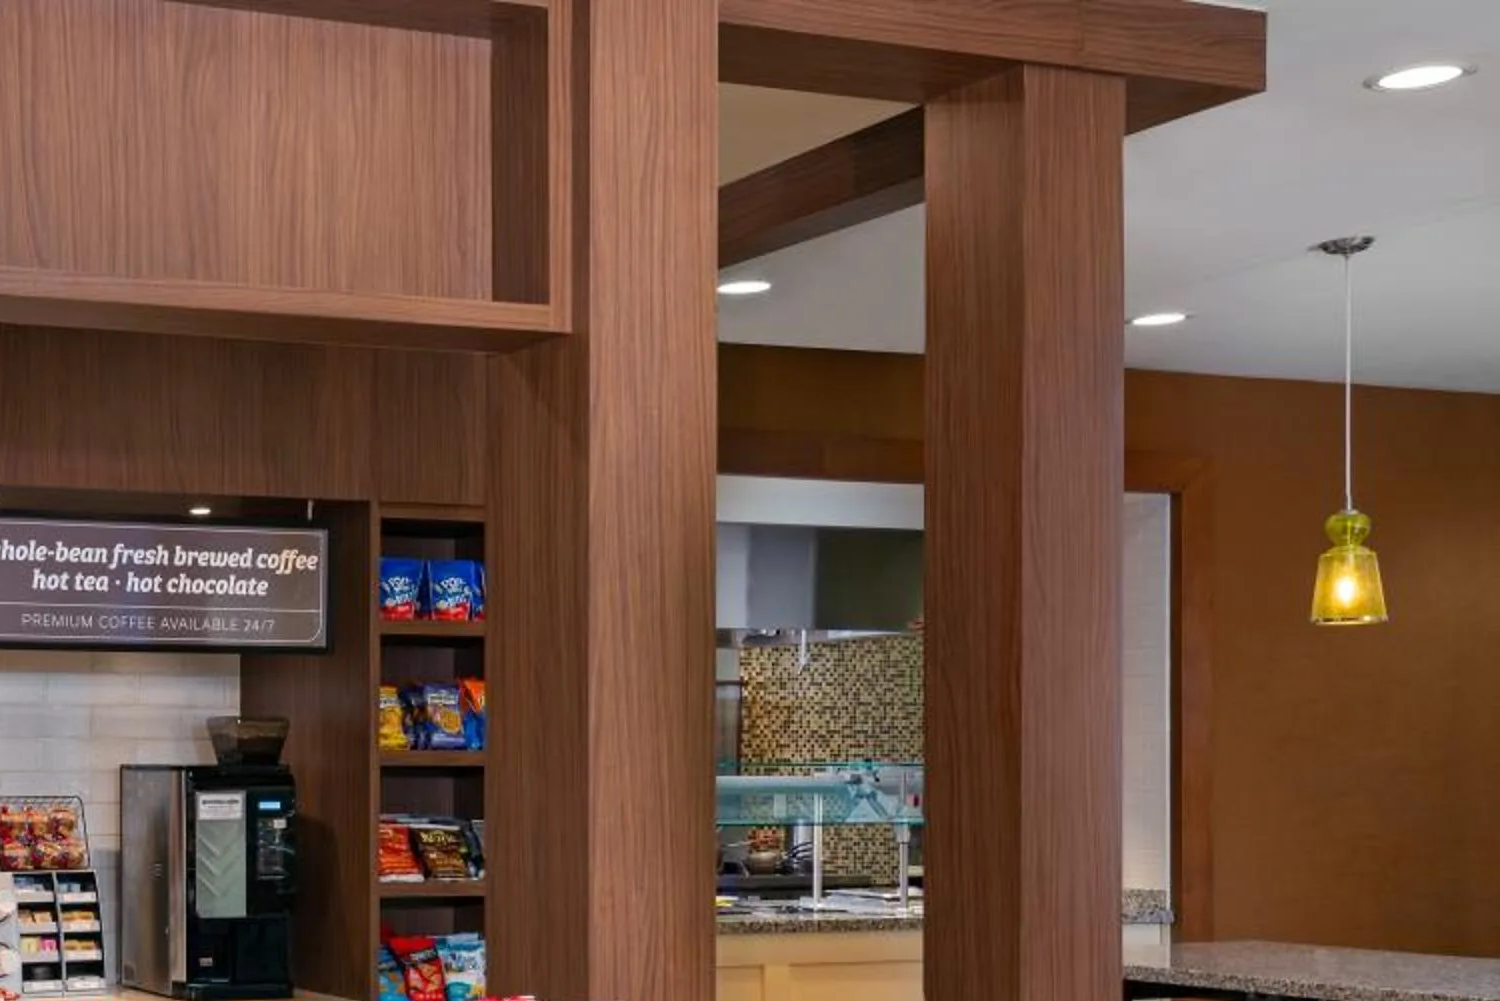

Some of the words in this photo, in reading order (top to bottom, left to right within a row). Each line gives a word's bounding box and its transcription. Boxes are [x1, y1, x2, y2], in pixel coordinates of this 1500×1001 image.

[109, 543, 173, 570] fresh
[174, 545, 252, 570] brewed
[248, 549, 319, 575] coffee
[32, 569, 70, 591] hot
[75, 573, 109, 592] tea
[126, 572, 162, 594] hot
[166, 573, 269, 597] chocolate
[20, 613, 94, 628] PREMIUM
[99, 614, 156, 631] COFFEE
[160, 616, 239, 632] AVAILABLE
[242, 618, 276, 633] 24/7
